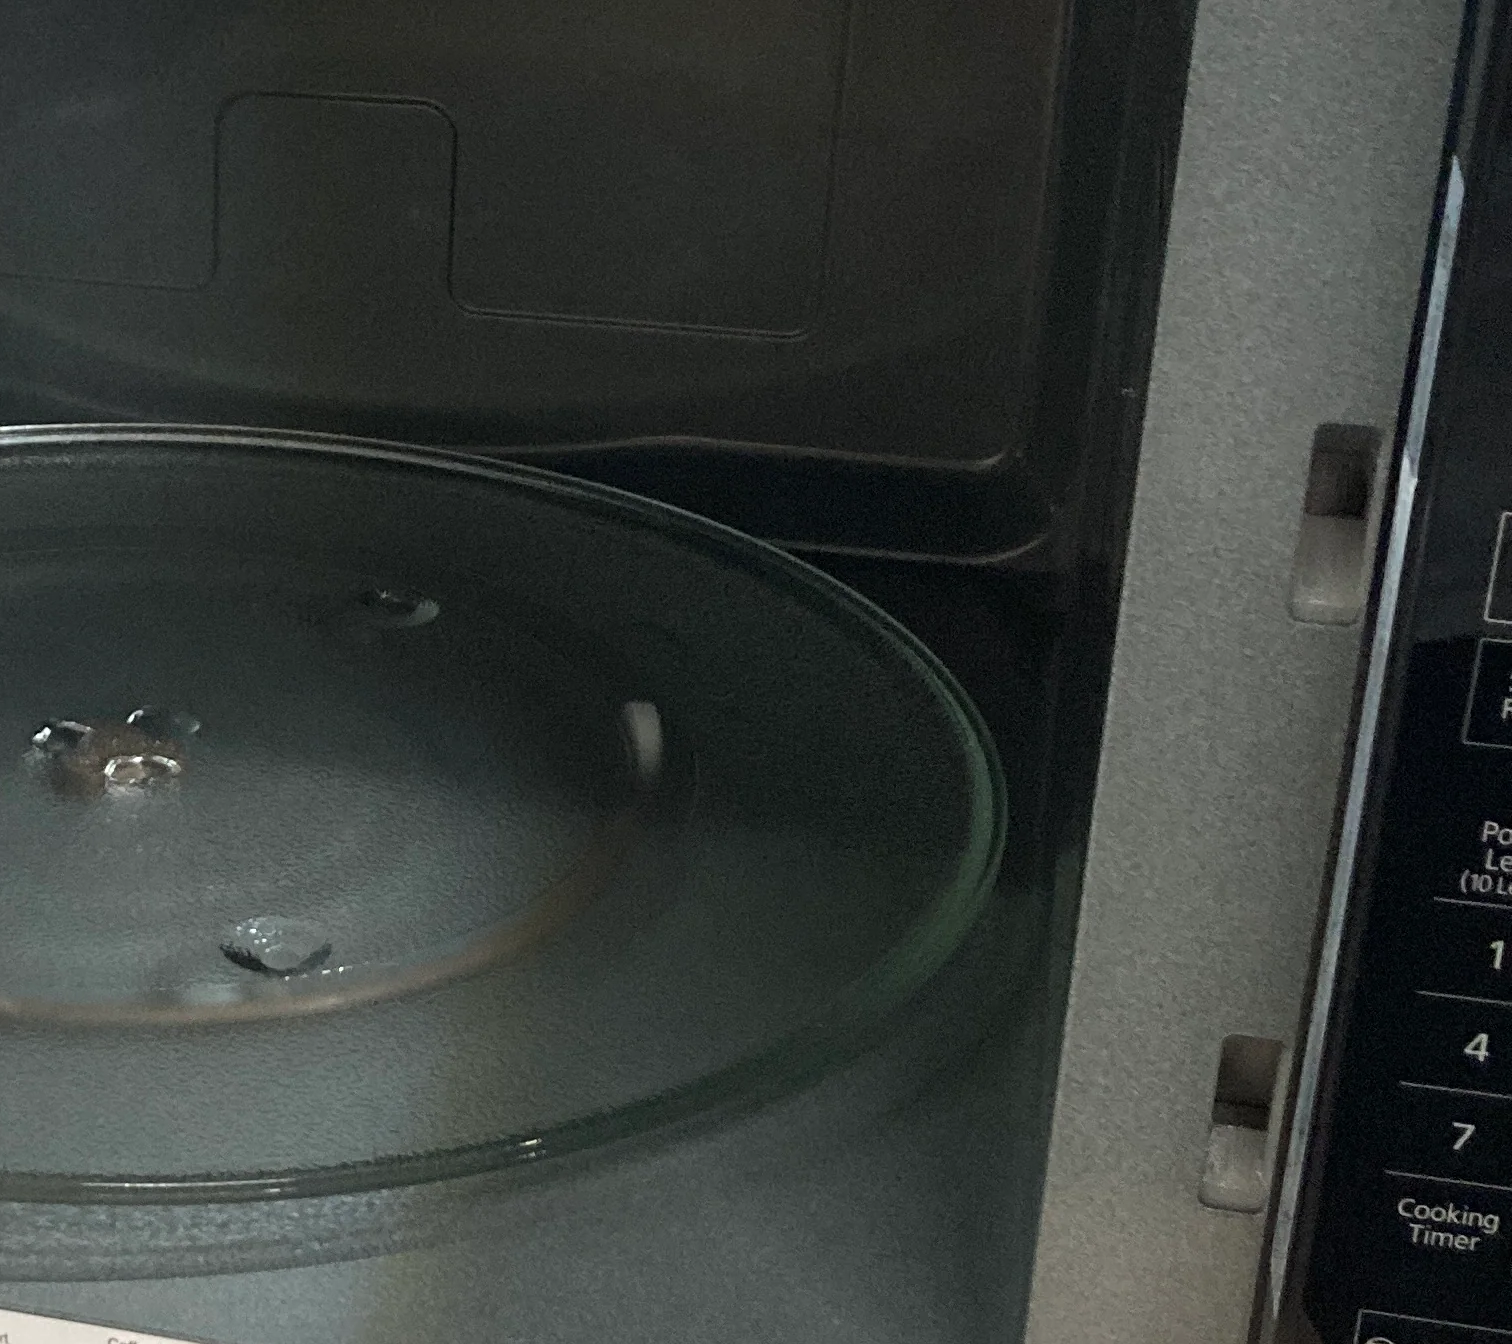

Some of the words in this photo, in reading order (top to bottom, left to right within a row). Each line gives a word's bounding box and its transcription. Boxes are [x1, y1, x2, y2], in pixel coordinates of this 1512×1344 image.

[1460, 869, 1492, 893] (10
[1490, 940, 1507, 970] 1
[1463, 1033, 1490, 1062] 4
[1452, 1122, 1476, 1150] 7
[1397, 1198, 1500, 1235] Cooking
[1409, 1222, 1481, 1251] Timer
